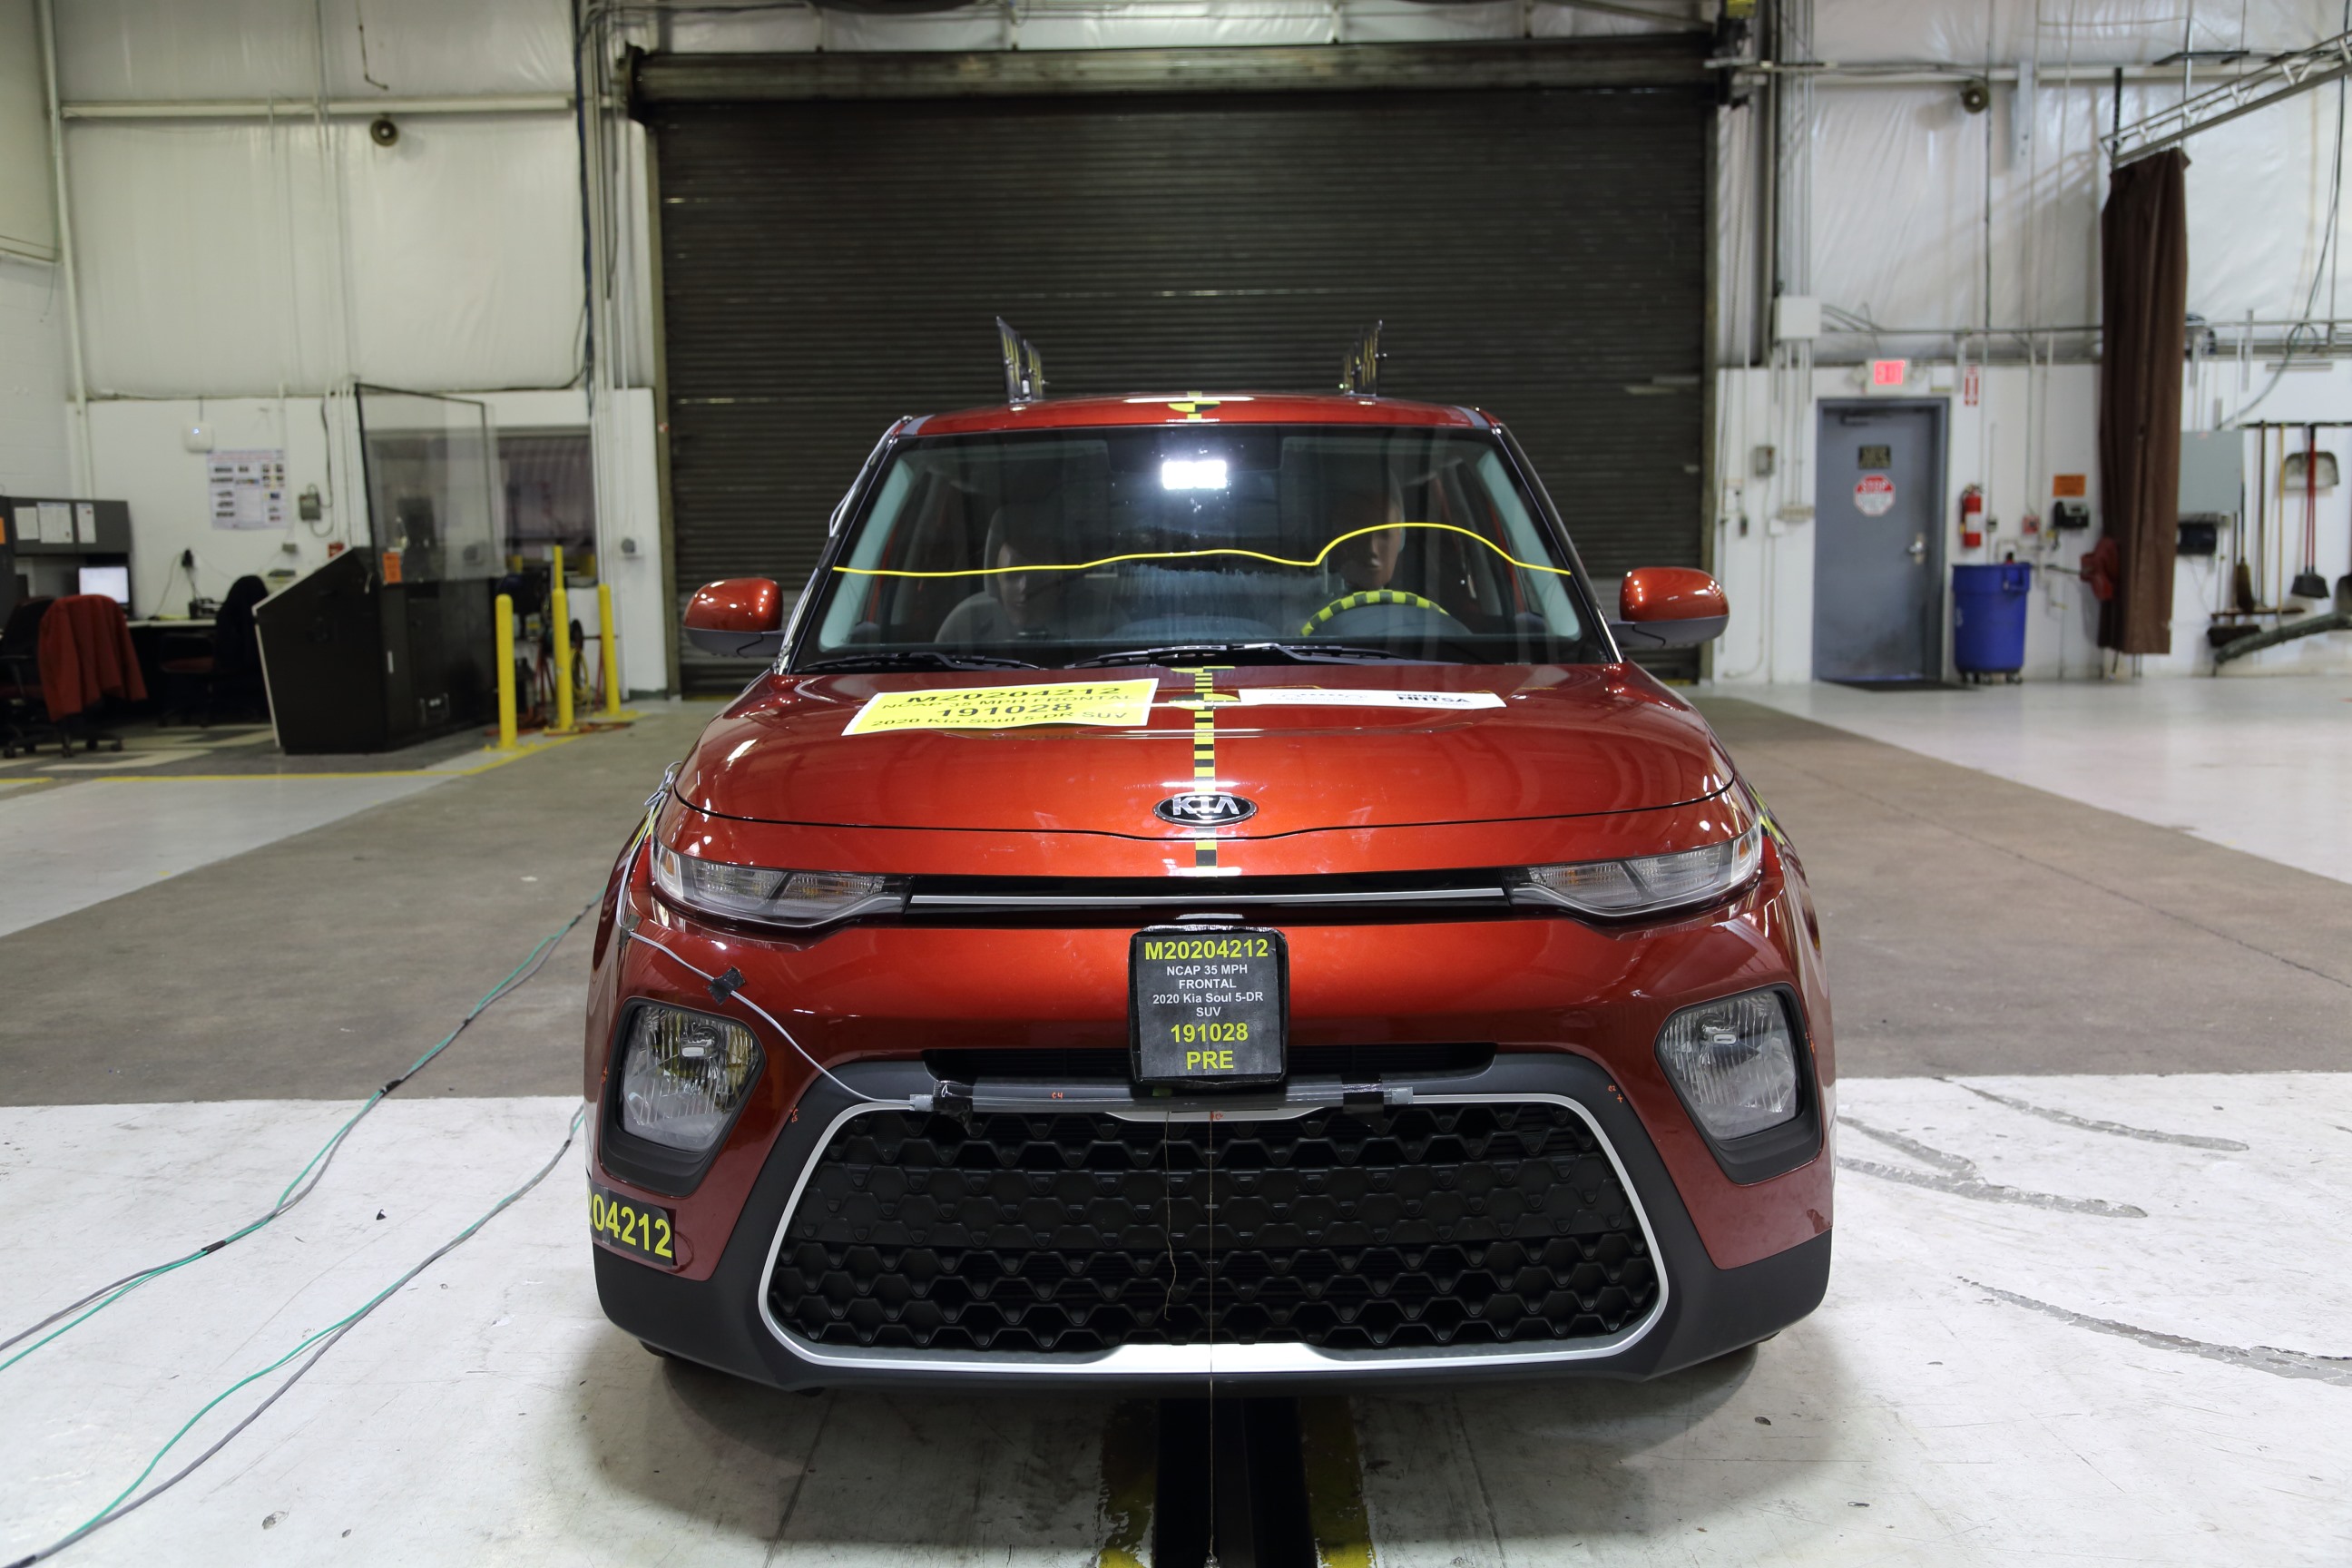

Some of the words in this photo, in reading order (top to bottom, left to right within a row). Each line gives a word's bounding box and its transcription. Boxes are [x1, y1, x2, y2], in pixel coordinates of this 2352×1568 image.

[907, 688, 1121, 702] M20204212
[937, 703, 1073, 717] 191028
[1171, 796, 1240, 816] KIA
[1145, 938, 1269, 960] M20204212
[1166, 965, 1201, 975] NCAP
[1204, 965, 1218, 975] 35
[1220, 964, 1248, 975] MPH
[1179, 978, 1237, 989] FRONTAL
[1152, 994, 1180, 1004] 2020
[1183, 993, 1202, 1004] Kia
[1205, 993, 1232, 1003] Soul
[1235, 992, 1264, 1002] 5-DR
[1196, 1006, 1221, 1017] SUV
[1171, 1023, 1249, 1043] 191028
[1186, 1050, 1234, 1070] PRE
